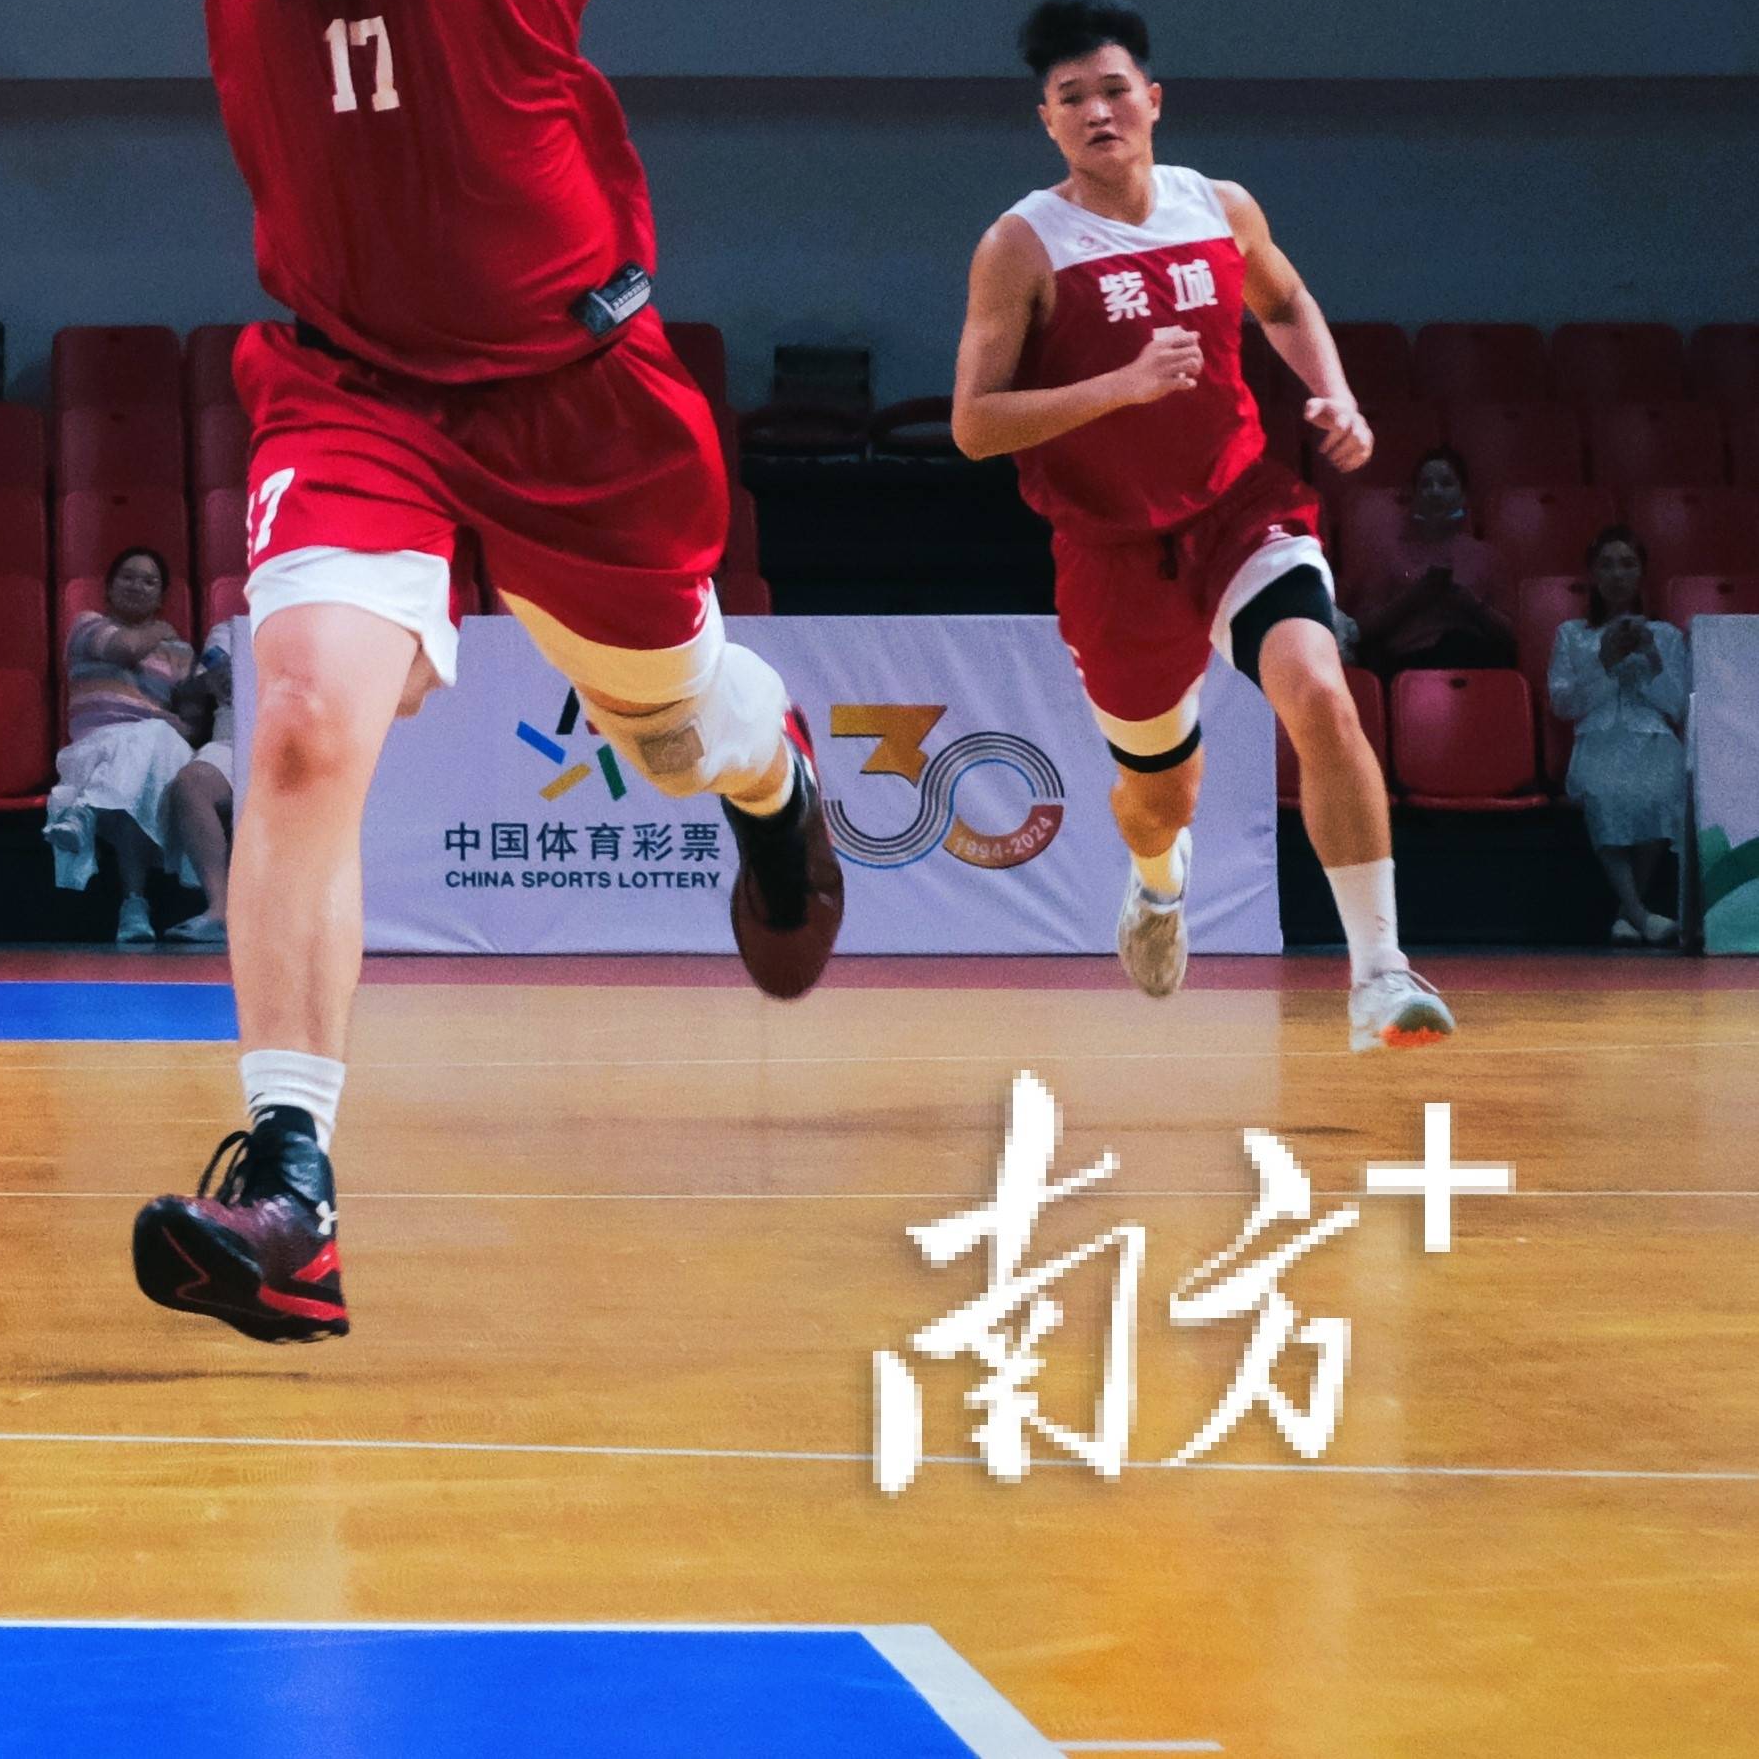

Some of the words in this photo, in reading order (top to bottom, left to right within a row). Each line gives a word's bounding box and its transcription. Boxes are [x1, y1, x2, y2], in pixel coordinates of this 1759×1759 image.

[325, 16, 400, 113] 17
[1099, 258, 1218, 323] 紫城
[444, 821, 721, 863] 中国体育彩票
[445, 870, 515, 888] CHINA
[521, 870, 611, 889] SPORTS
[618, 871, 721, 889] LOTTERY
